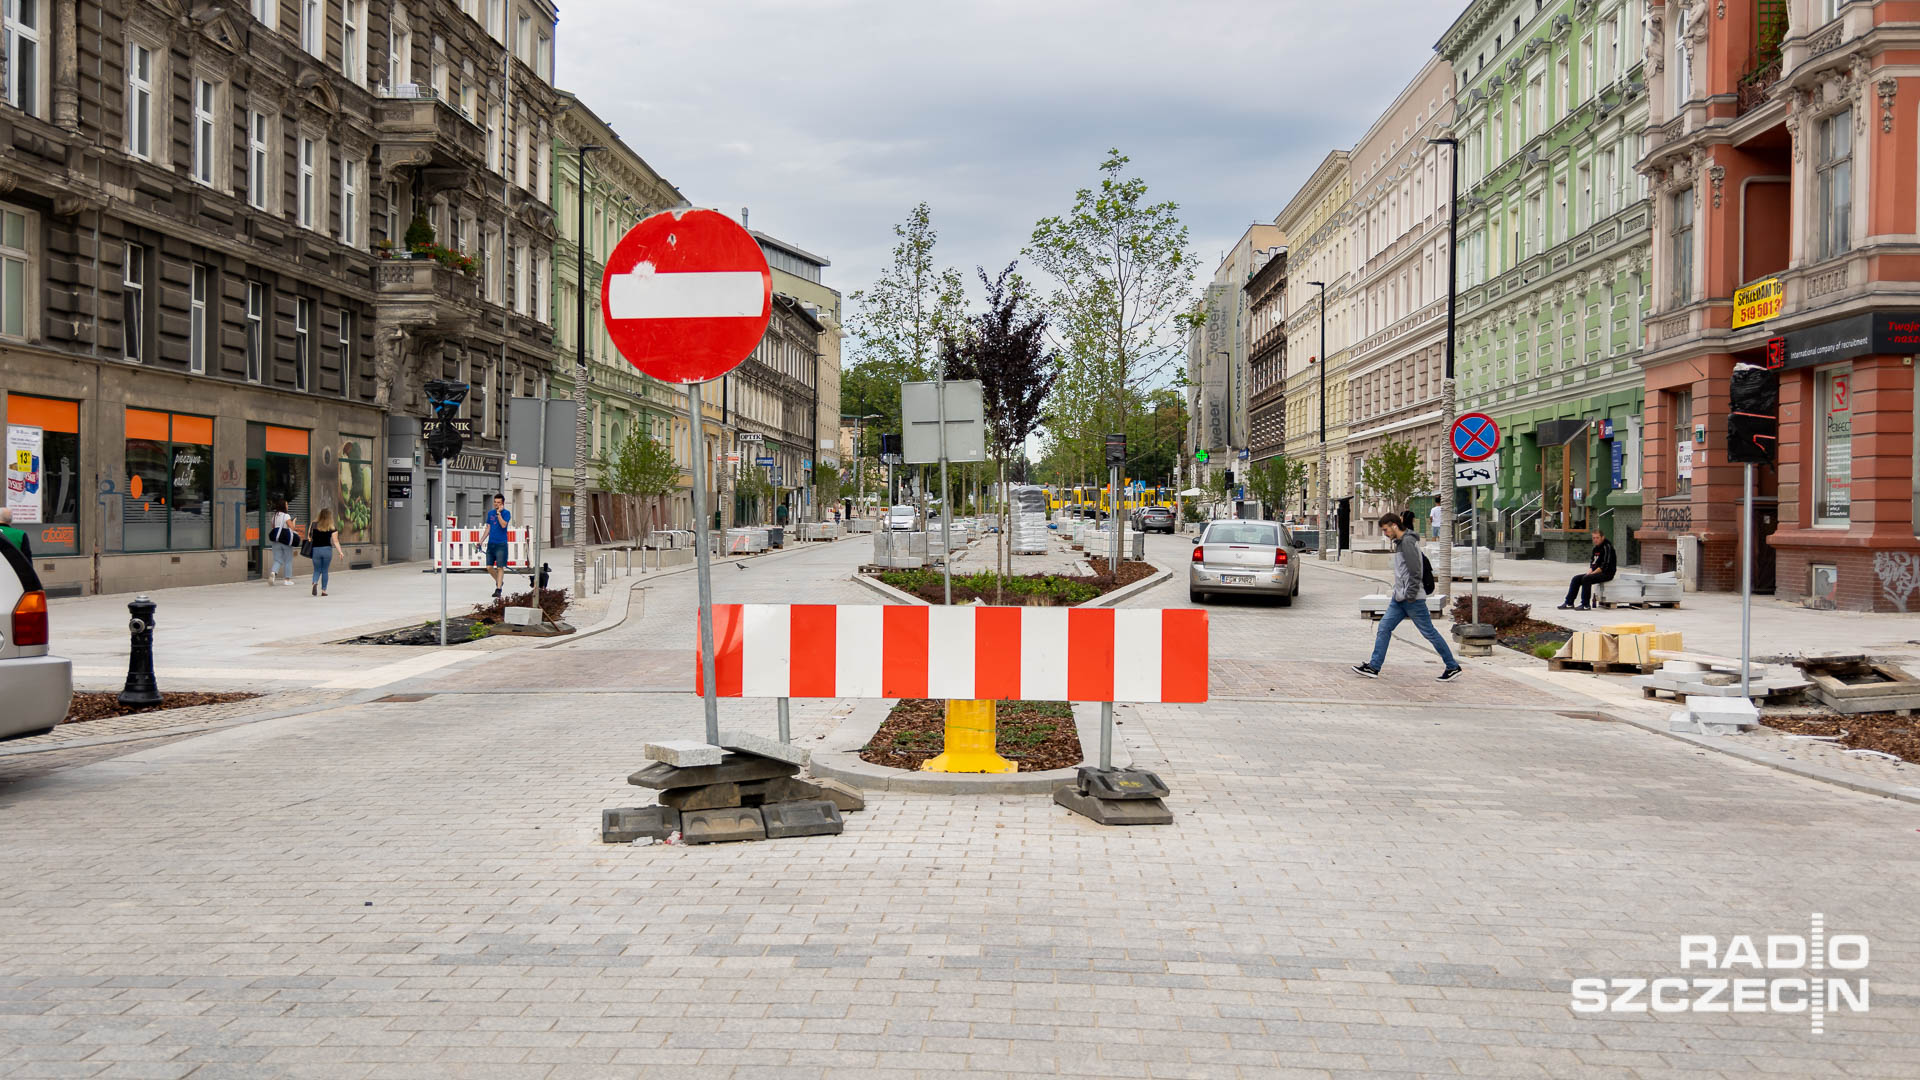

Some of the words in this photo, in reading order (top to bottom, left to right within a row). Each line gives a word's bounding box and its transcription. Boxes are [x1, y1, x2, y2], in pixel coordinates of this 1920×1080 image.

[1738, 283, 1772, 306] SPRZEDAM
[1740, 306, 1755, 322] 519
[1758, 301, 1773, 318] 501
[1209, 307, 1220, 353] weber
[1888, 321, 1920, 333] Twoje
[1790, 347, 1816, 359] International
[1817, 344, 1835, 356] company
[1836, 341, 1841, 351] of
[1841, 337, 1868, 349] recruitment
[423, 421, 470, 431] ZŁNIK
[1209, 400, 1222, 449] weber
